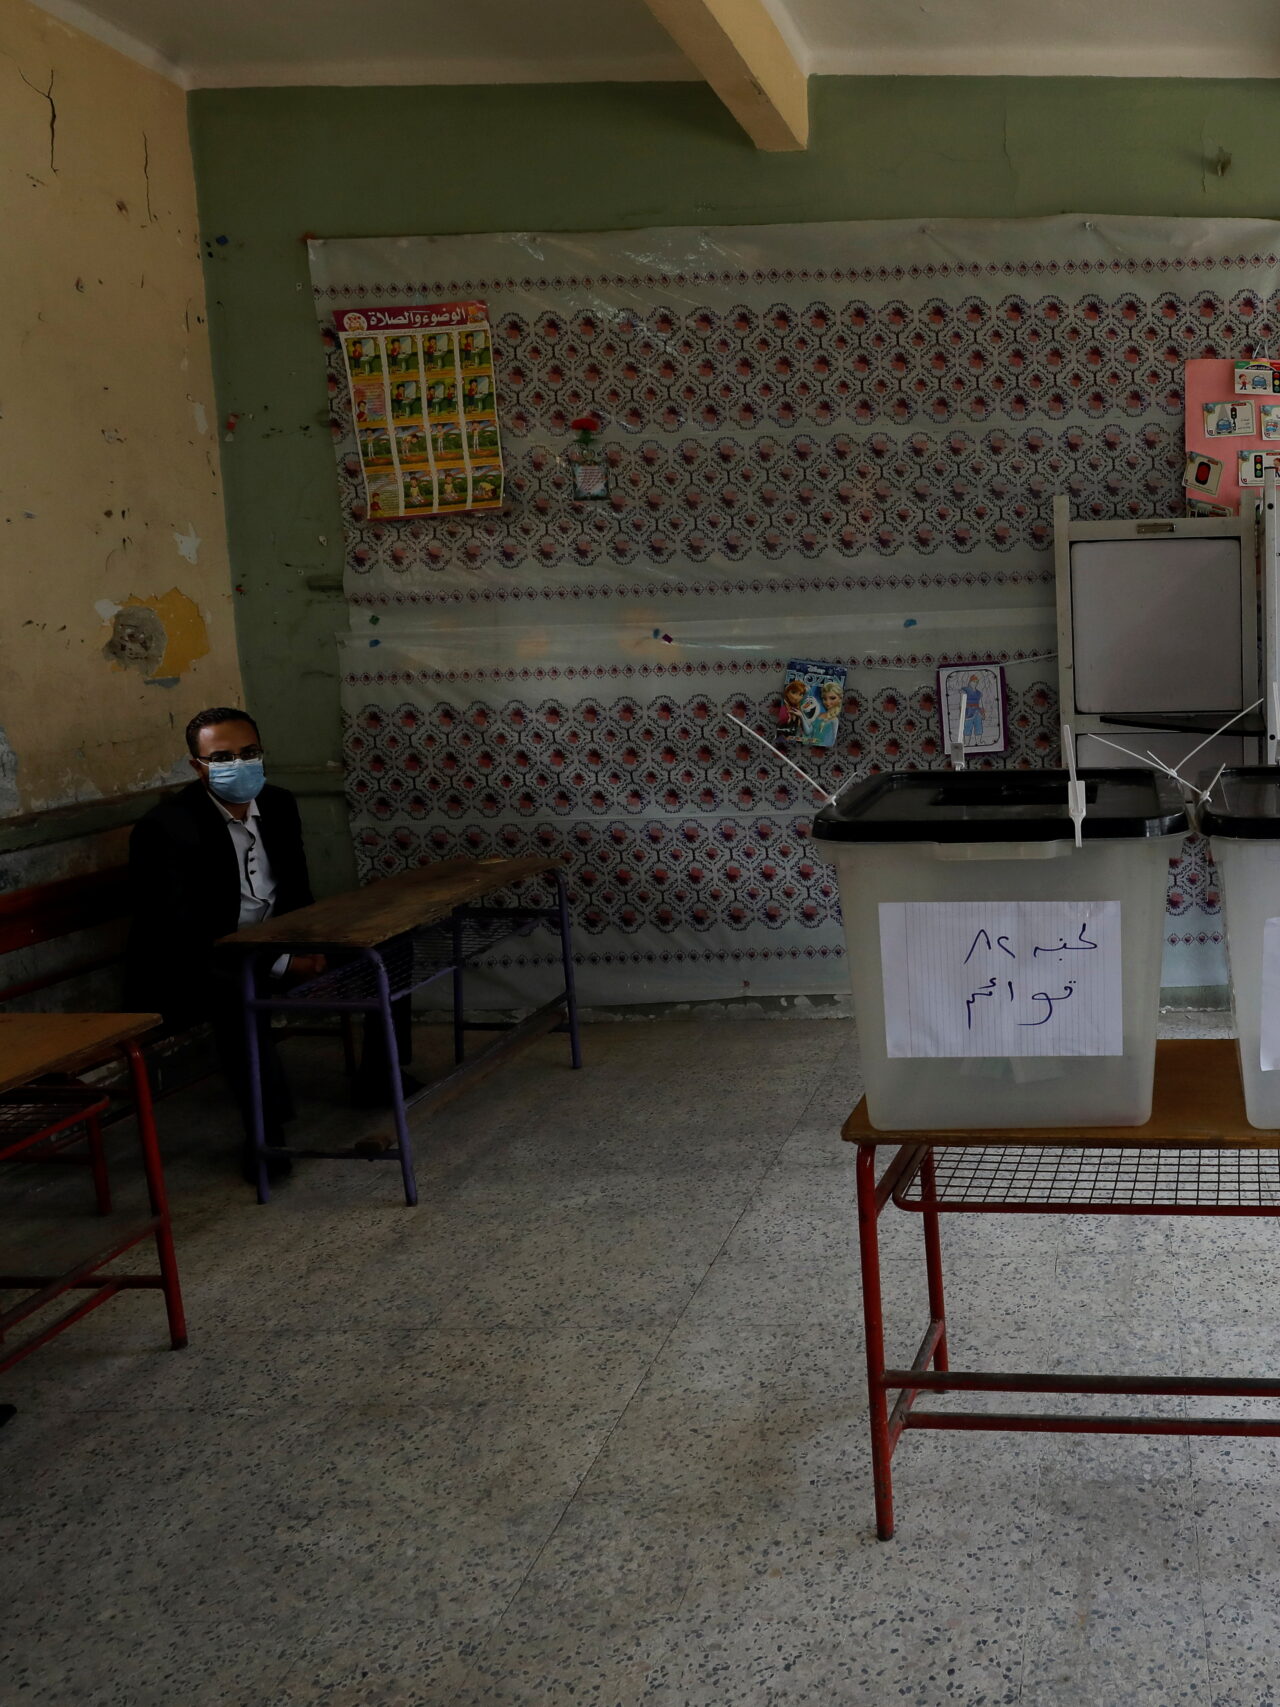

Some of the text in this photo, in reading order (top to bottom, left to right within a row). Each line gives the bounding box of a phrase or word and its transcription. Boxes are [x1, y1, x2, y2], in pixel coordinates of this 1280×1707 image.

[368, 310, 421, 327] والصلاة
[422, 307, 466, 327] الوضوء
[965, 977, 1077, 1030] قوائم
